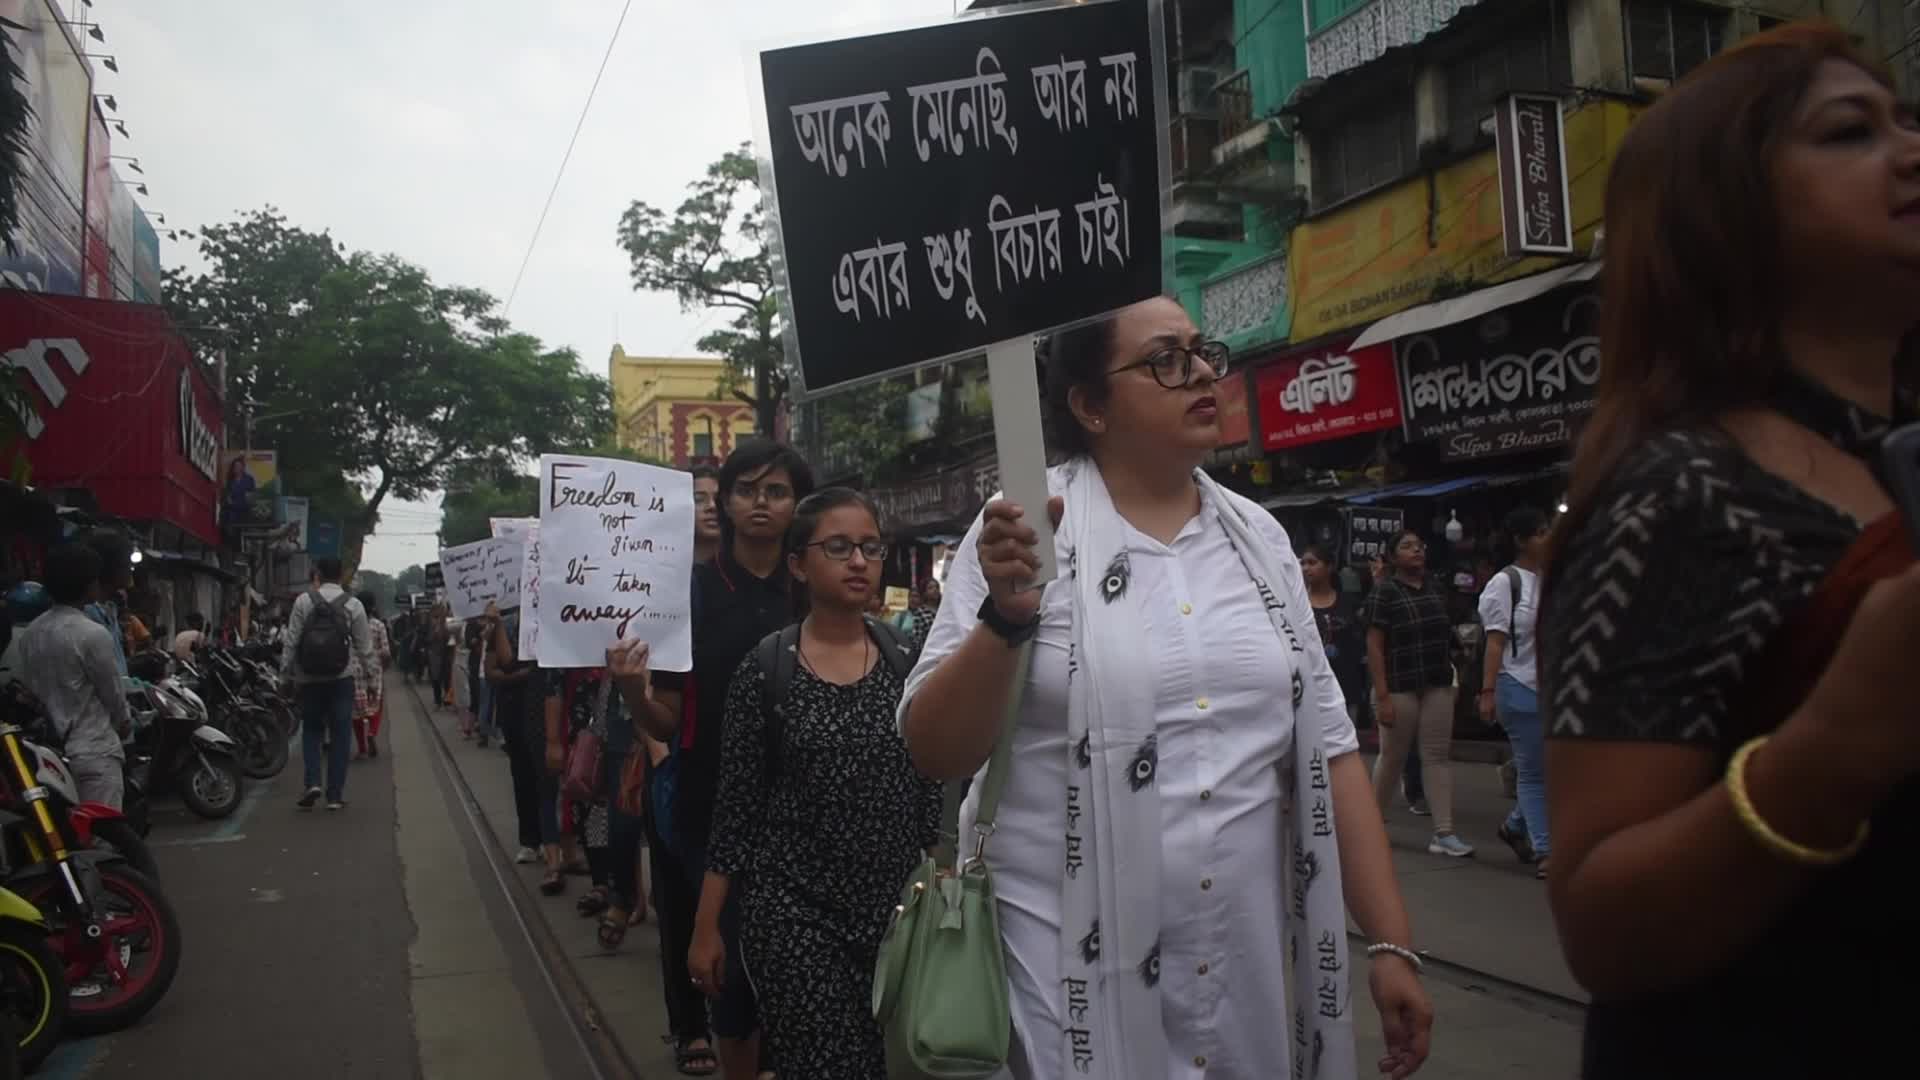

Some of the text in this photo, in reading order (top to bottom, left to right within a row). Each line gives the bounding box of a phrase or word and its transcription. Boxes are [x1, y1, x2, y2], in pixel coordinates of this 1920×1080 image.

[790, 91, 890, 177] অনেক
[1031, 55, 1088, 133] আর
[1099, 52, 1138, 120] নয়
[832, 237, 911, 321] এবার
[924, 228, 987, 325] শুধু
[988, 194, 1063, 293] বিচার
[1279, 352, 1360, 413] এলিট
[1448, 433, 1491, 456] Silpa
[551, 463, 664, 512] Freedom is
[600, 511, 637, 532] not
[612, 568, 651, 596] taken
